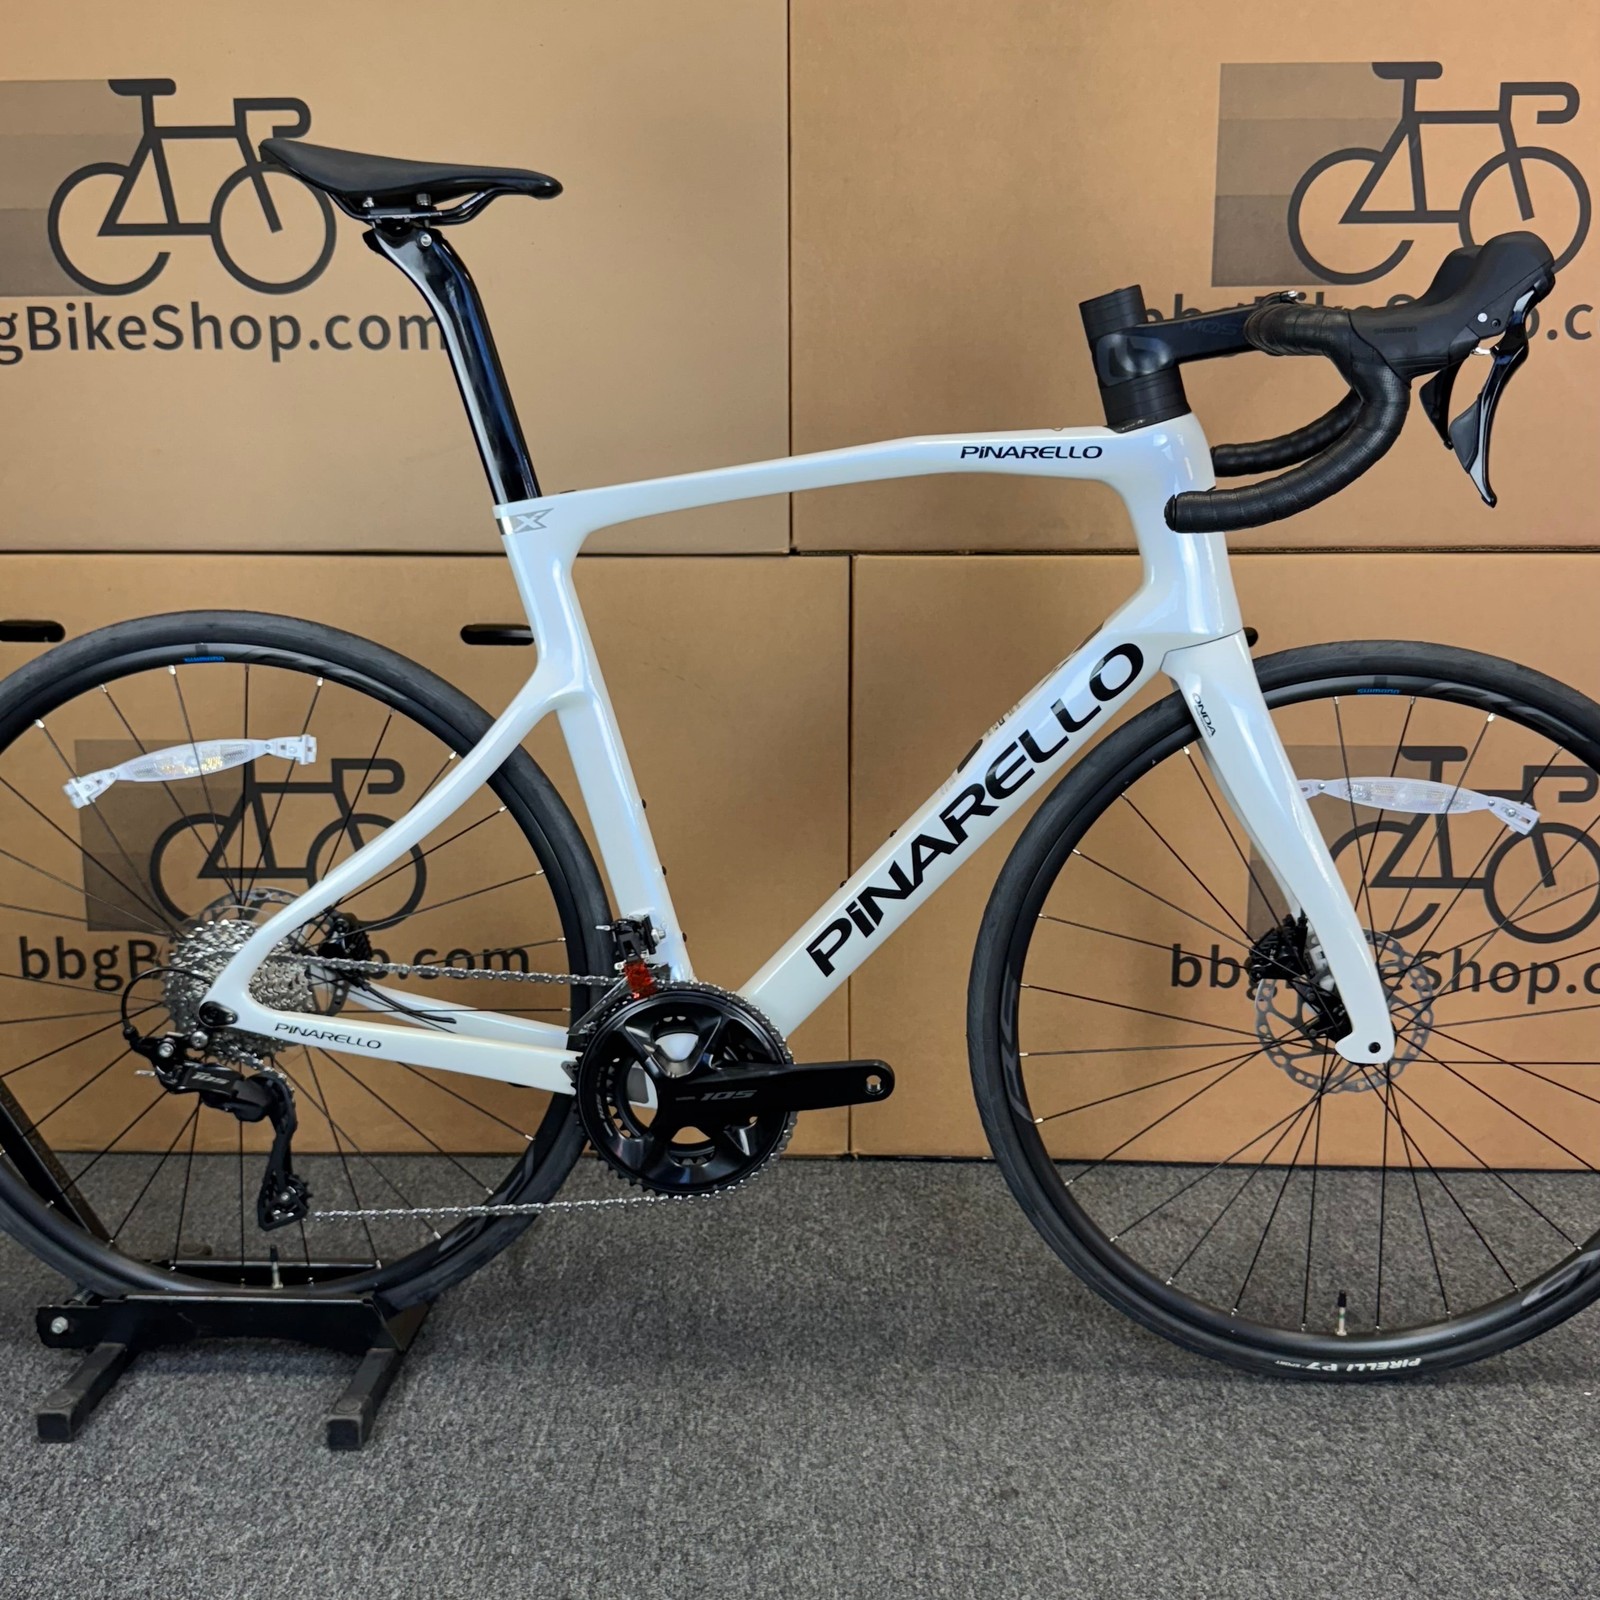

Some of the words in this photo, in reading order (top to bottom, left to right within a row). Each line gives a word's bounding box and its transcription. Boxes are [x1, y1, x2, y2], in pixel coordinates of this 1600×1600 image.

[1192, 692, 1216, 736] ONDA
[701, 1089, 758, 1101] 105
[1306, 1361, 1338, 1372] P7
[1345, 1357, 1422, 1372] PIRELLI
